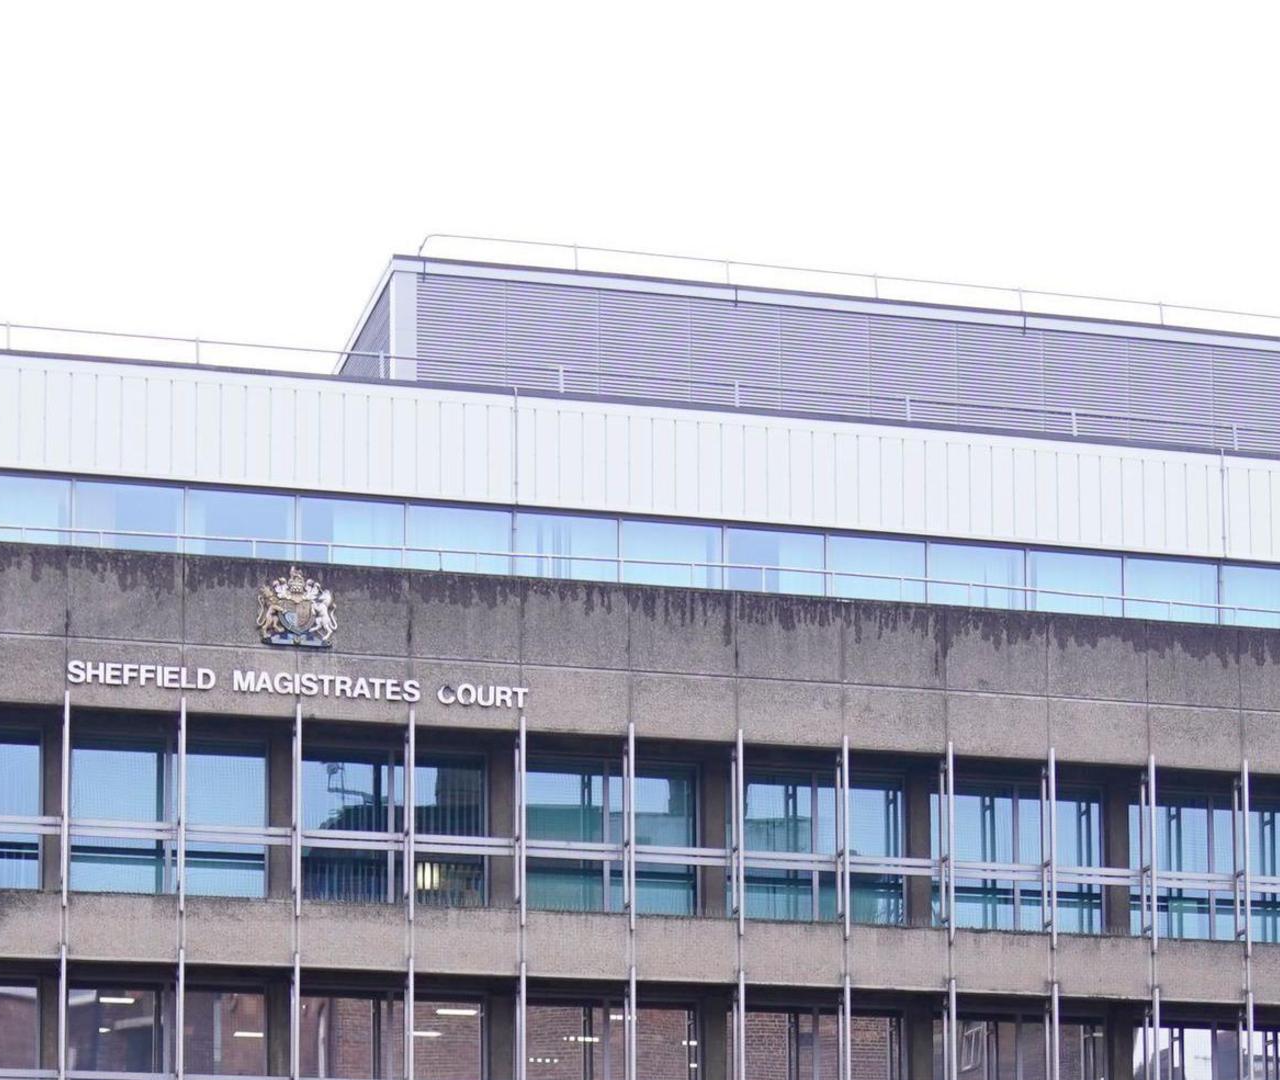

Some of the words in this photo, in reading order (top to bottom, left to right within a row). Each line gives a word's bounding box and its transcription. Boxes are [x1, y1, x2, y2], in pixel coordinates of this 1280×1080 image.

[67, 660, 216, 690] SHEFFIELD
[232, 669, 421, 703] MAGISTRATES
[437, 683, 529, 709] COURT
